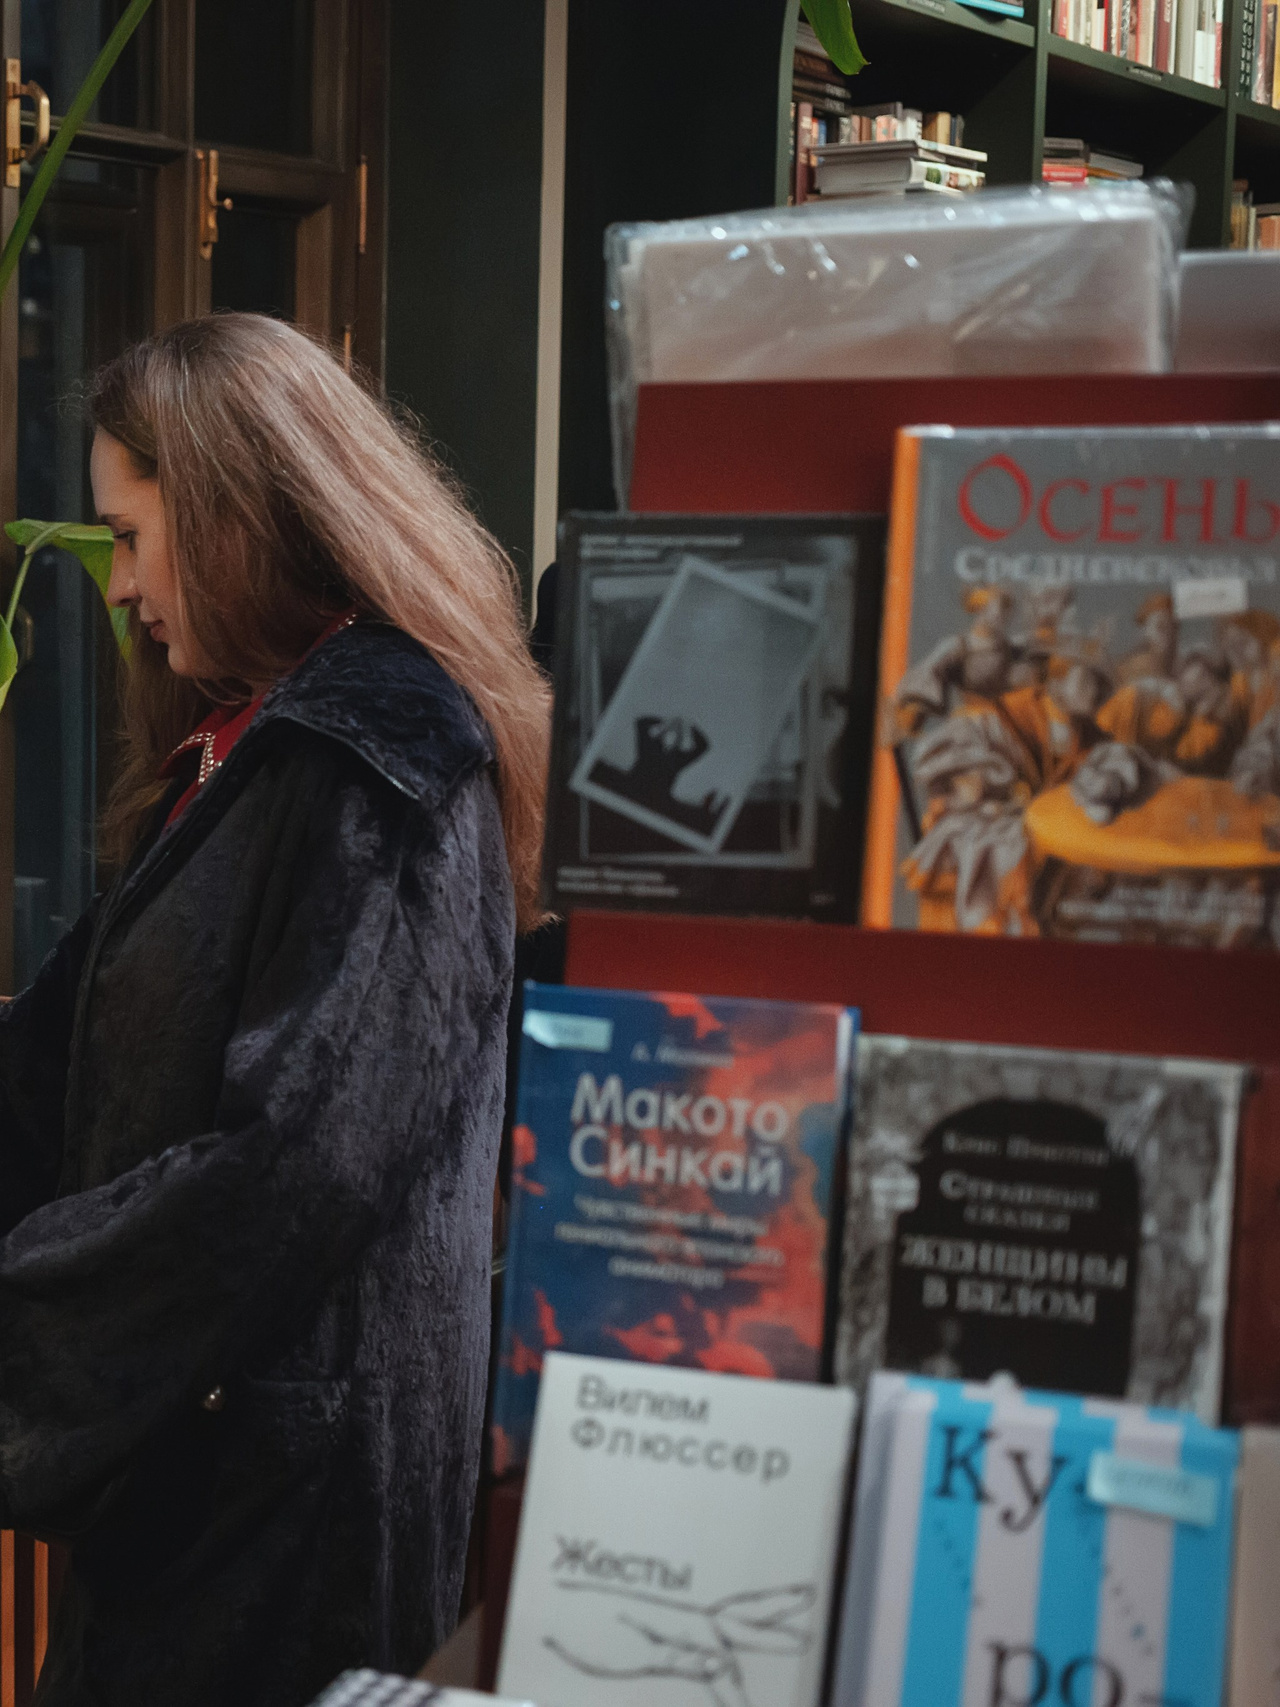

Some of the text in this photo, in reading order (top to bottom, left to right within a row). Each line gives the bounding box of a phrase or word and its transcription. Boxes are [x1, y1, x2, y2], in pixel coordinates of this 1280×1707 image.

[571, 1072, 789, 1142] Макото
[569, 1124, 782, 1196] Синкай
[576, 1373, 710, 1423] Вилем
[570, 1416, 791, 1486] Флюссер
[934, 1426, 1087, 1532] Ку
[550, 1535, 693, 1592] Жесты
